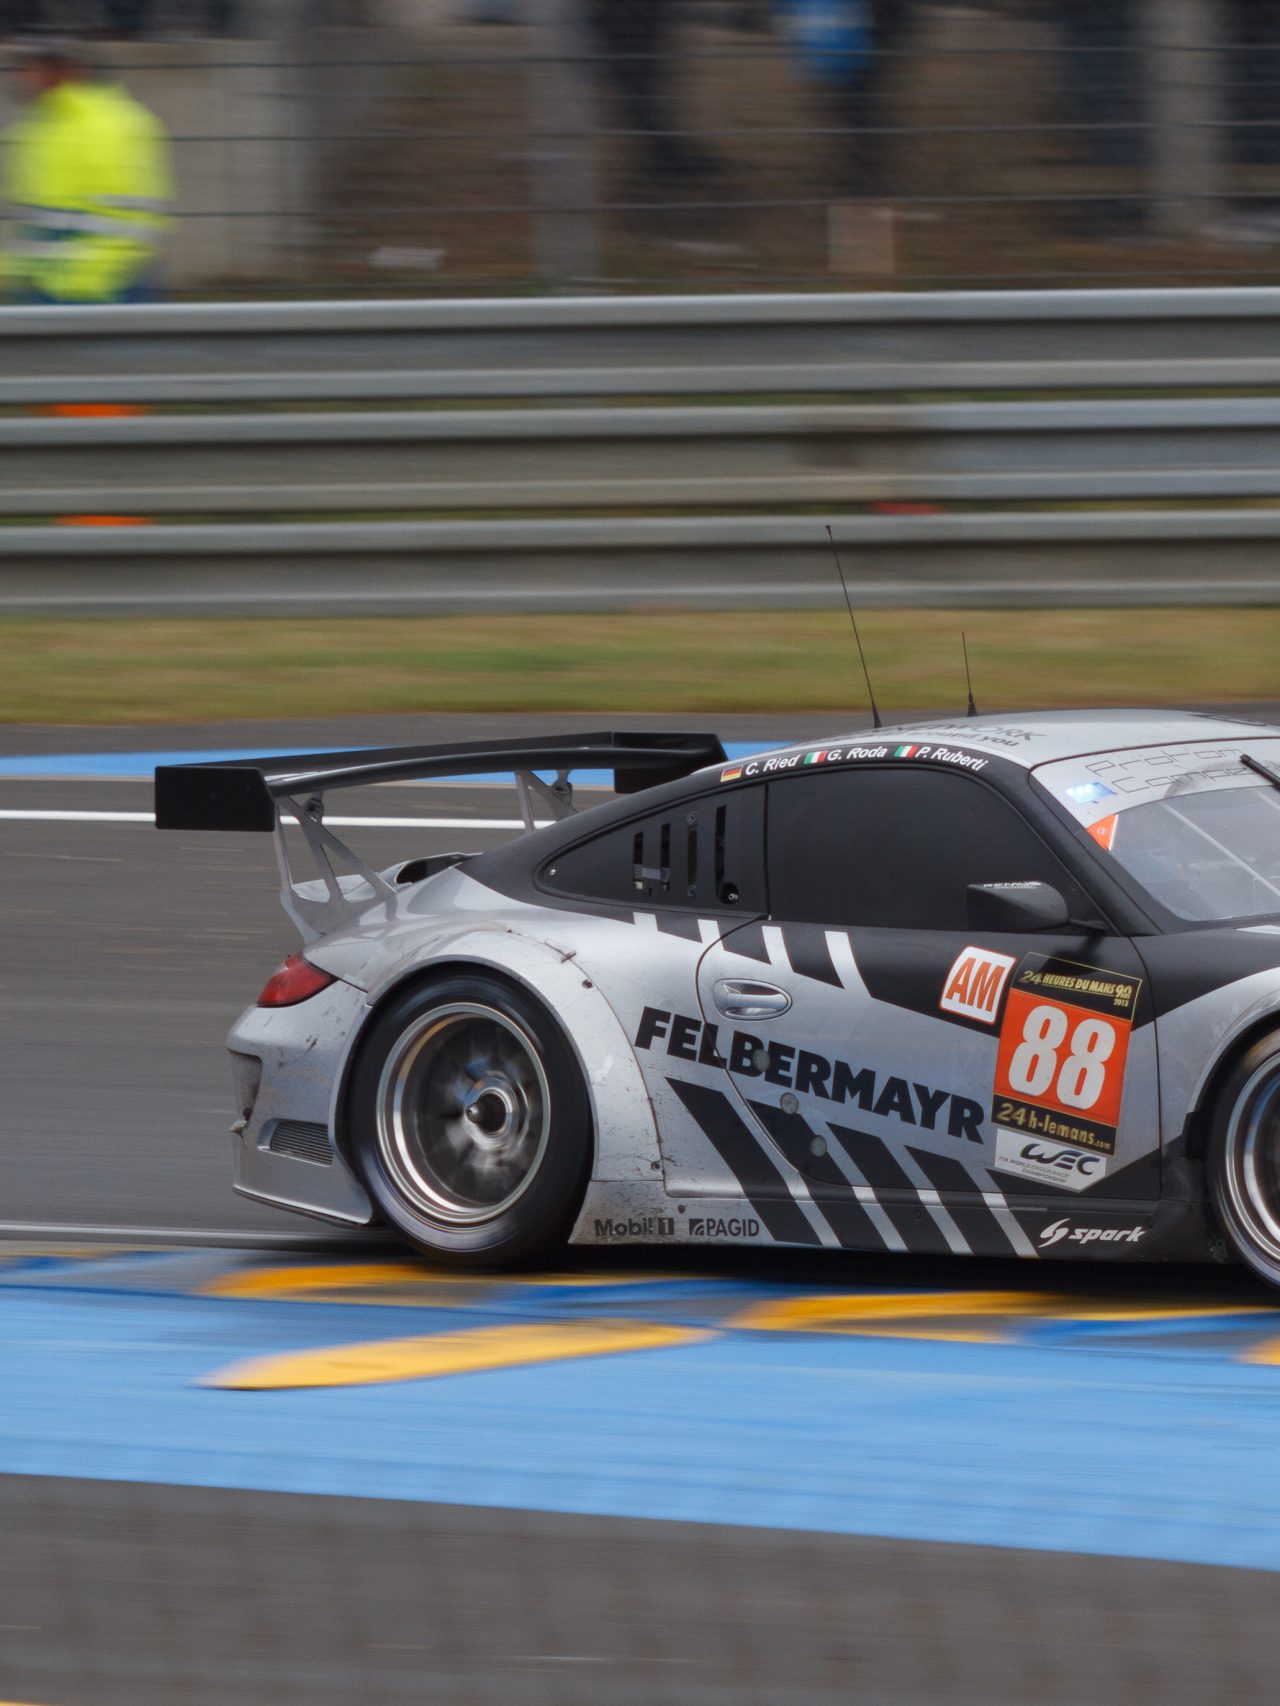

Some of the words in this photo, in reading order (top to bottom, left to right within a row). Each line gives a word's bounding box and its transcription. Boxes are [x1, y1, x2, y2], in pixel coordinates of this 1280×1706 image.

[977, 736, 1020, 747] you
[745, 762, 759, 775] C.
[763, 754, 801, 772] Ried
[827, 750, 842, 761] G.
[847, 746, 888, 760] Roda
[914, 746, 928, 758] P.
[931, 748, 989, 771] Ruberti
[1085, 747, 1246, 777] Proton
[945, 957, 1005, 1013] AM
[1020, 970, 1042, 985] 24
[1042, 973, 1076, 988] HEURES
[1075, 978, 1089, 990] DU
[1089, 980, 1116, 994] MANS
[1113, 999, 1129, 1007] 2013
[1008, 1005, 1116, 1110] 88
[634, 1006, 985, 1145] FELBERMAYR
[1020, 1143, 1101, 1176] WEC
[660, 1218, 673, 1235] 1
[706, 1218, 760, 1237] PAGID
[1068, 1226, 1147, 1244] spark
